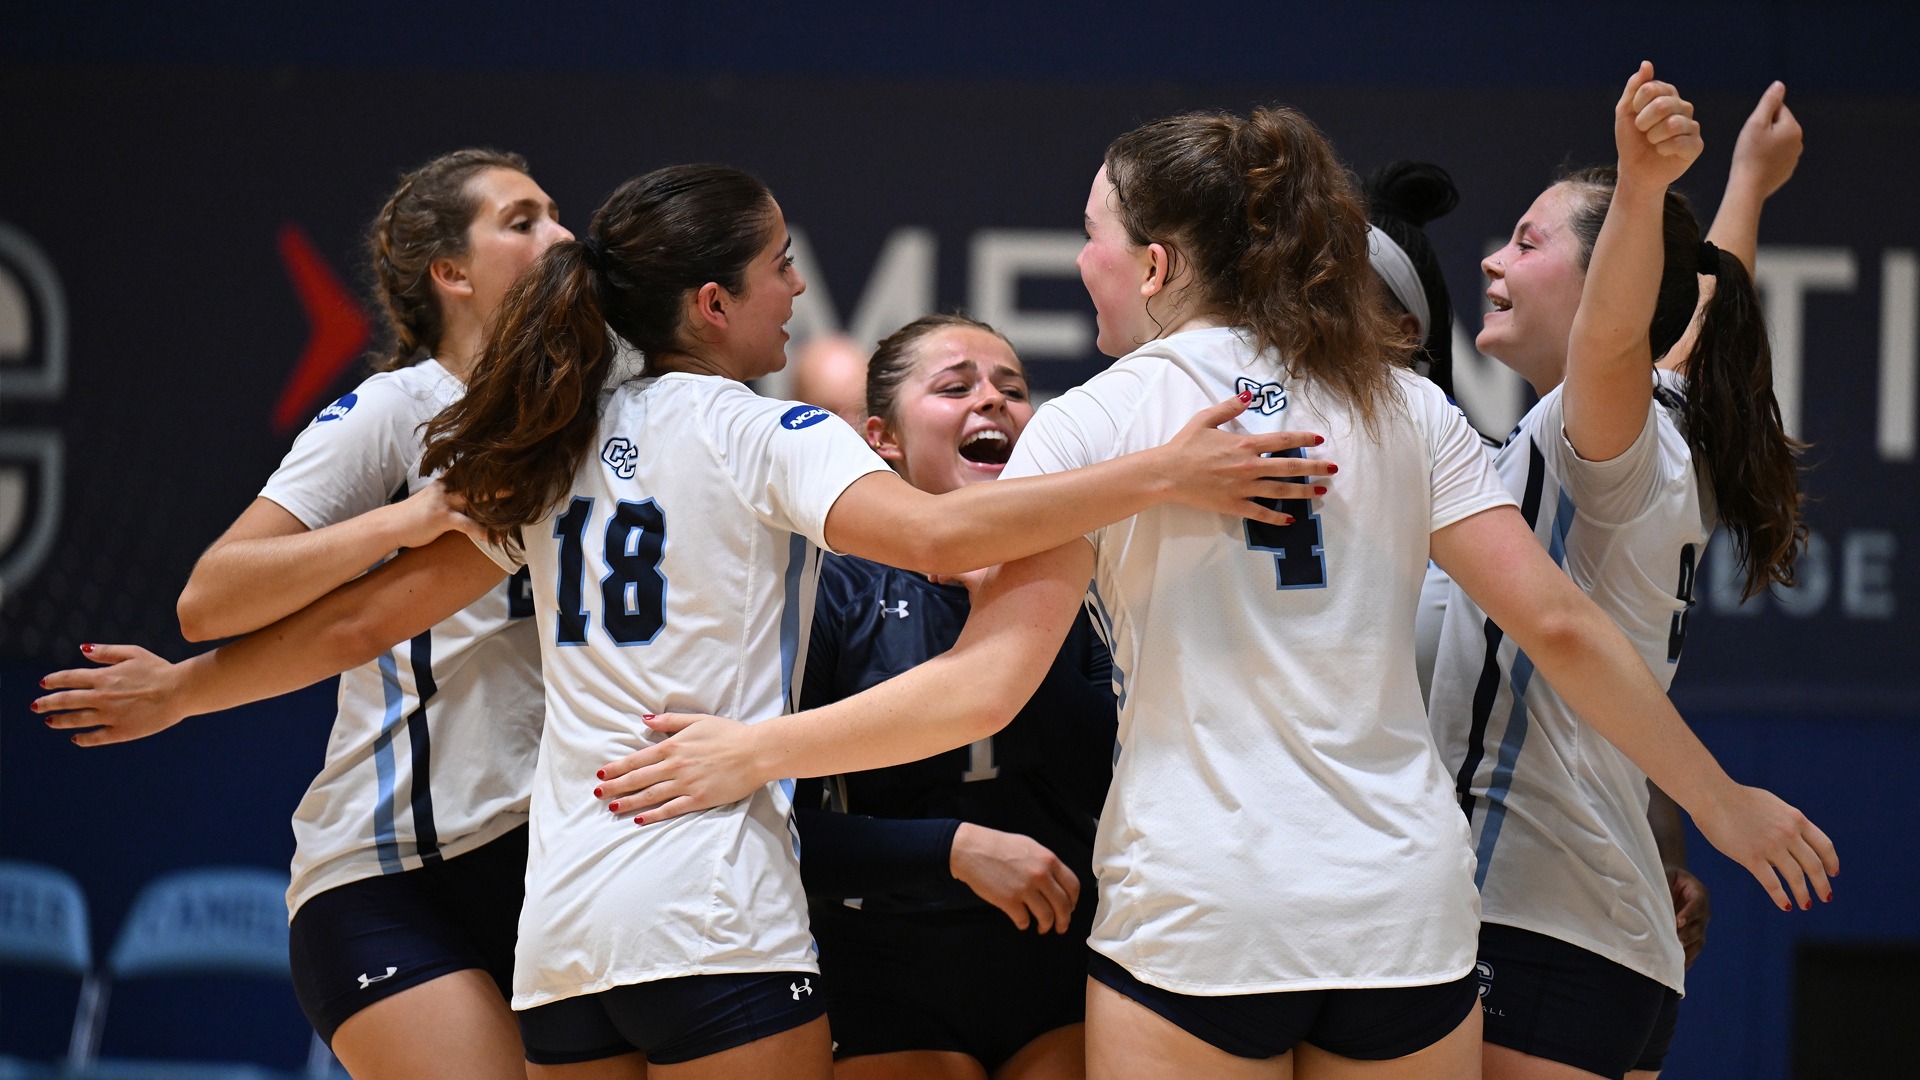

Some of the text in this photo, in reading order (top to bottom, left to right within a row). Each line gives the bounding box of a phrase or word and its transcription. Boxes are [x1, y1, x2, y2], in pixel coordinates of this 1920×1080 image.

[789, 408, 830, 428] NCAA
[553, 495, 668, 647] 18
[1243, 446, 1327, 590] 4
